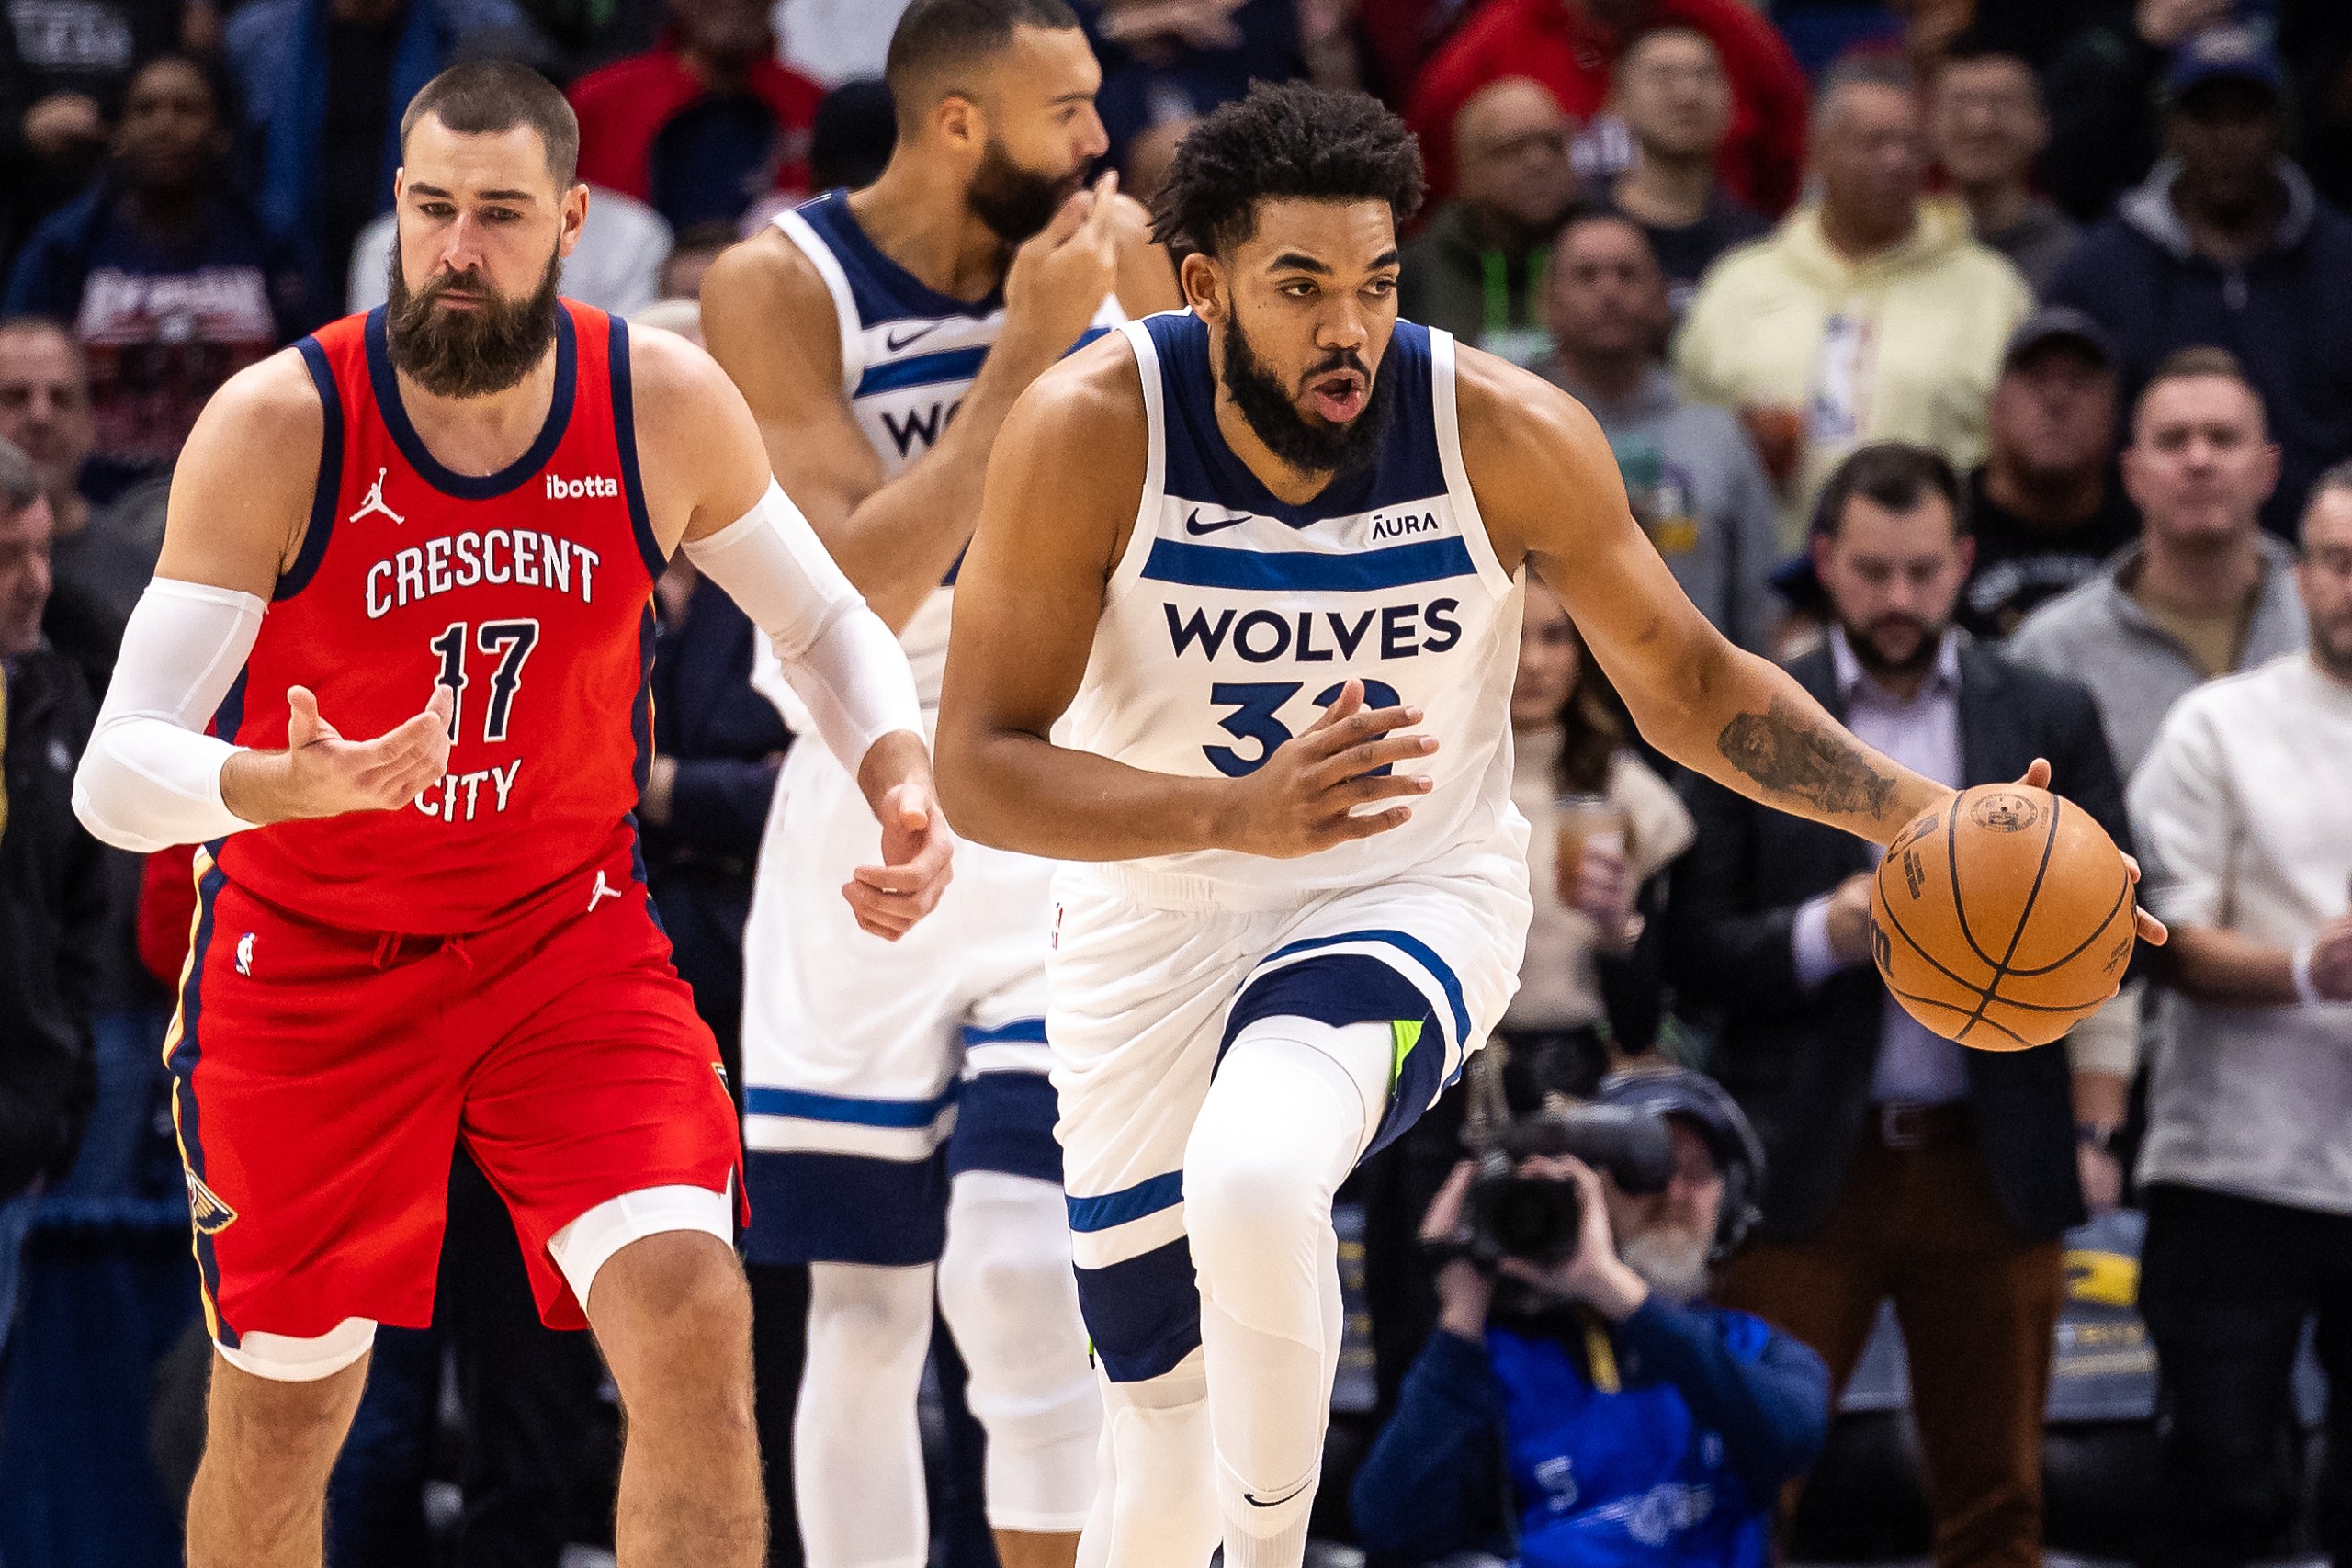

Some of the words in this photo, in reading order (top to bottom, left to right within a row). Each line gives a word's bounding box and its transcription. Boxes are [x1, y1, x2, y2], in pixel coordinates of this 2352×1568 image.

[546, 473, 618, 500] ibotta
[366, 529, 600, 619] CRESCENT
[1162, 597, 1464, 663] WOLVES
[429, 618, 540, 745] 17
